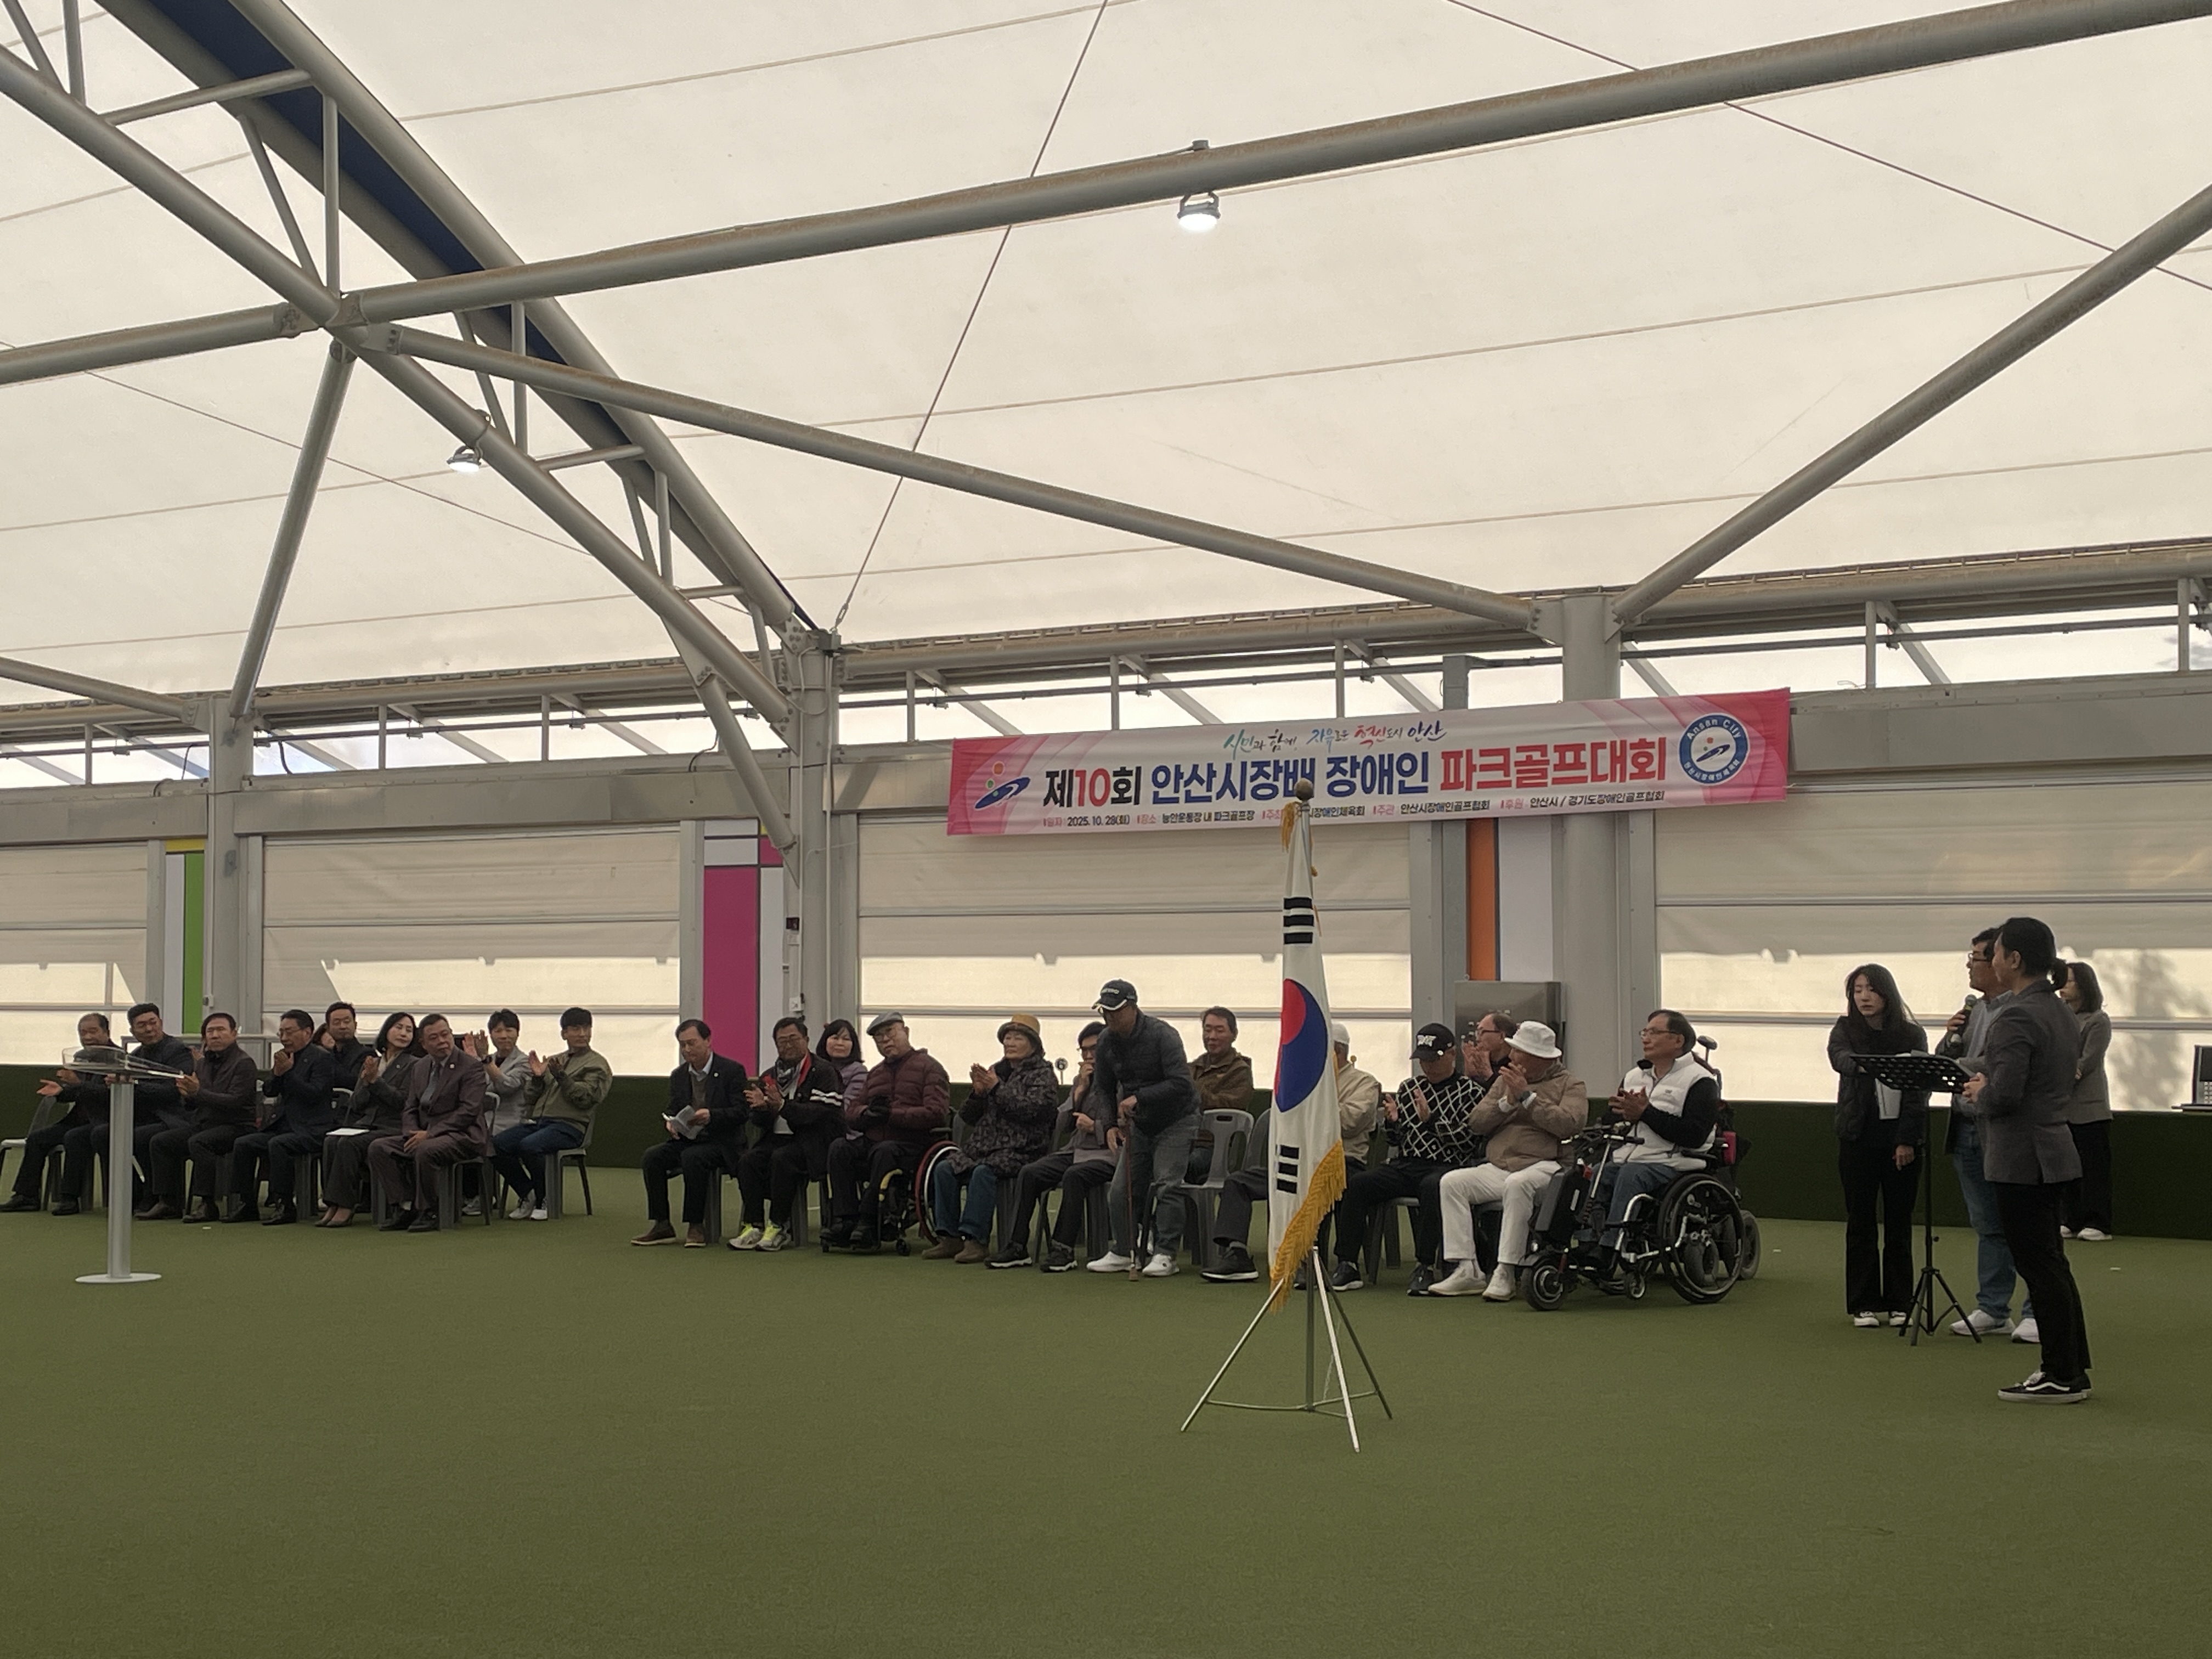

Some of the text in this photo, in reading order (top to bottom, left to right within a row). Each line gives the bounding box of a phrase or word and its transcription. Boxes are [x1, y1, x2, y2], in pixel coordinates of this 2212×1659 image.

[1407, 720, 1447, 742] 안산
[1687, 719, 1741, 740] Ansan City
[1043, 737, 1667, 808] 제10회 안산시장배 장애인 파크골프대회
[1530, 795, 1558, 808] 안산시
[1568, 791, 1665, 806] 경기도장애인골프협회
[1067, 816, 1090, 827] 2025.
[1092, 815, 1103, 825] 10.
[1214, 810, 1255, 821] 파크골프장
